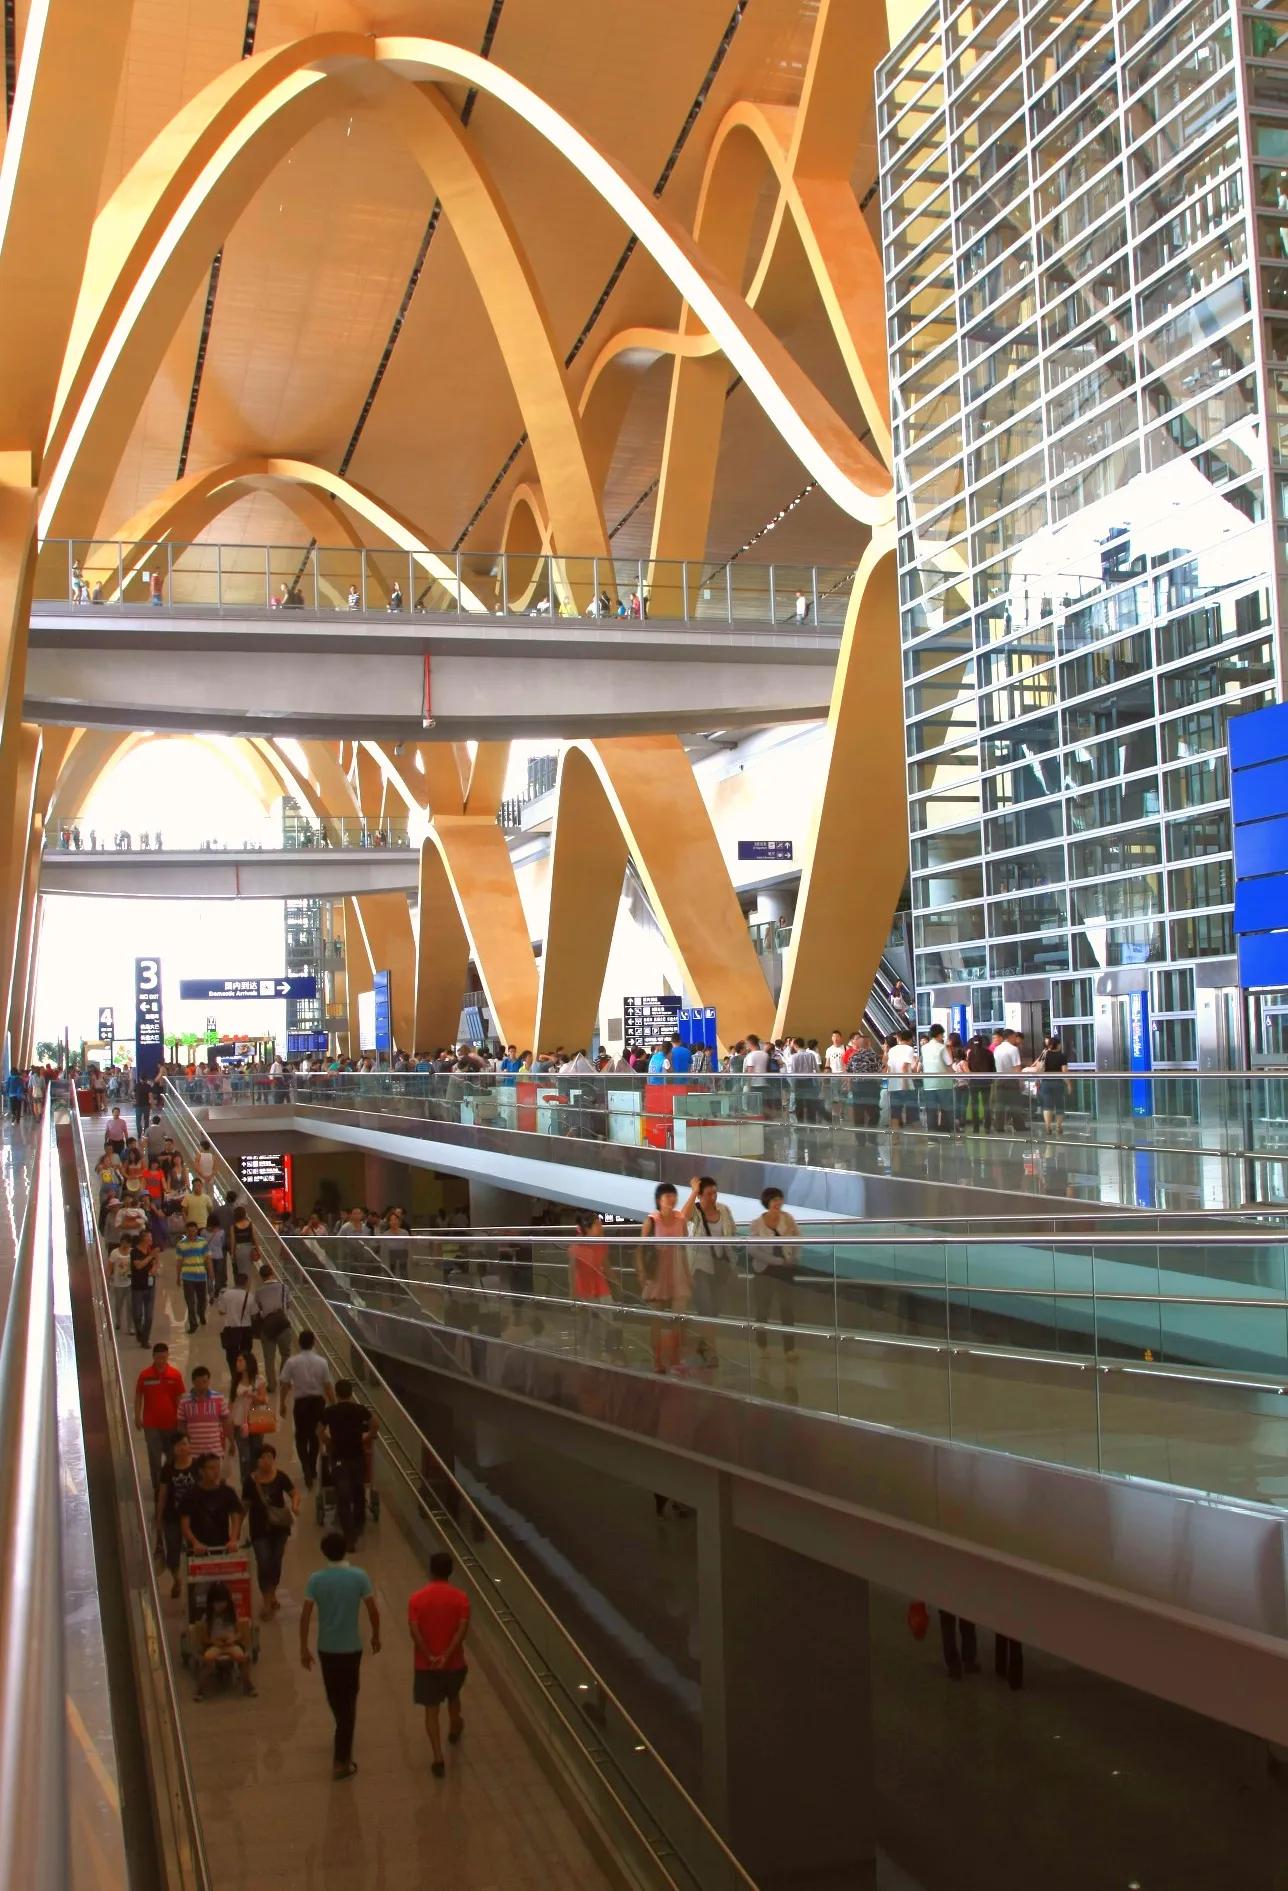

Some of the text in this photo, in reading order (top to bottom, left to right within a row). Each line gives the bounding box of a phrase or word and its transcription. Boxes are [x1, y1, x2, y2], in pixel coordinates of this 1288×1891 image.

[140, 960, 158, 989] 3
[224, 981, 257, 990] 国内到达
[100, 1008, 113, 1026] 4
